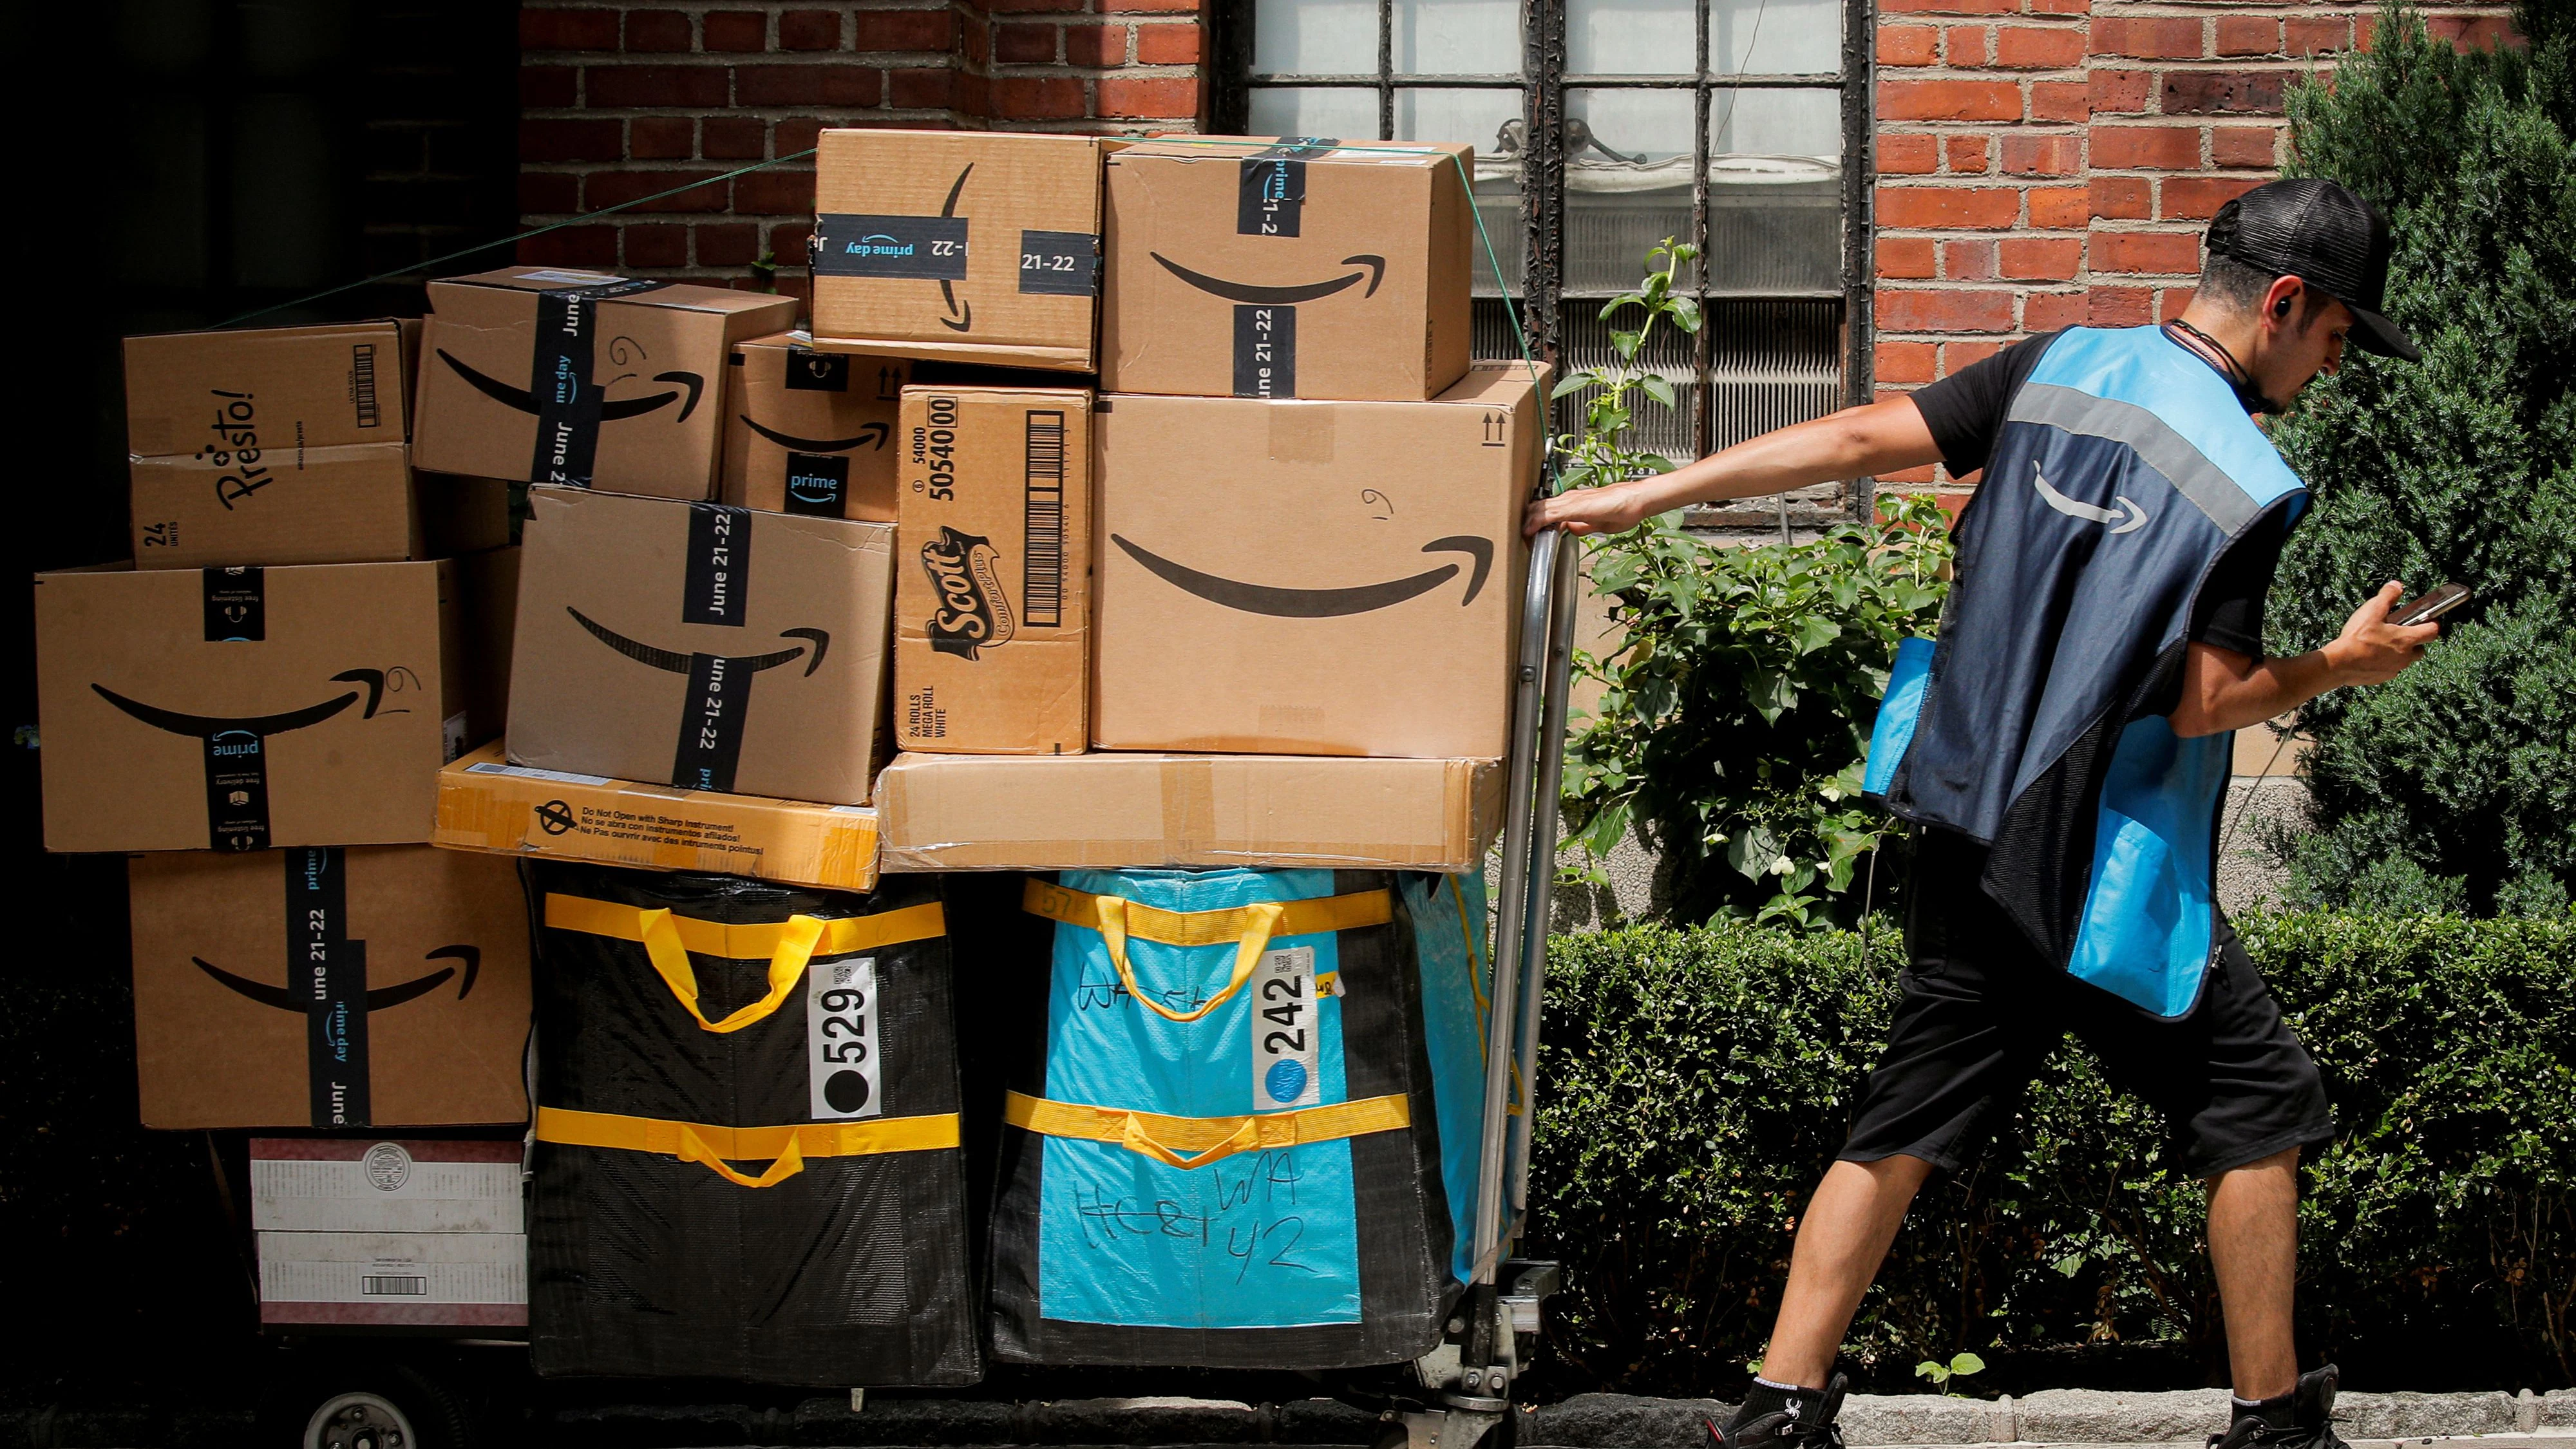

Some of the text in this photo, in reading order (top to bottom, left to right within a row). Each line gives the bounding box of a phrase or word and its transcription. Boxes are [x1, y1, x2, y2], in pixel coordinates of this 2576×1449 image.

[846, 242, 873, 256] day
[873, 243, 914, 258] prime
[1021, 254, 1075, 271] 21-22
[563, 294, 580, 337] June
[1255, 309, 1272, 361] 21-22
[555, 355, 571, 404] me day
[211, 389, 274, 511] Presto!
[553, 422, 573, 465] June
[913, 427, 926, 464] 54000
[929, 399, 955, 501] 50540 00
[791, 473, 837, 489] prime
[144, 522, 166, 547] 24
[709, 514, 731, 616] June 21-22
[923, 549, 986, 639] Scott
[709, 658, 725, 692] une
[699, 697, 723, 750] 21-22
[909, 694, 920, 737] 24 ROLLS
[922, 685, 934, 737] MEGA ROLL
[934, 708, 946, 738] WHITE
[213, 741, 259, 758] prime
[580, 826, 591, 835] Ne
[594, 827, 609, 837] Pas
[641, 834, 662, 843] avec
[663, 835, 679, 845] des
[728, 844, 764, 855] pointus!
[581, 816, 594, 825] No
[607, 820, 626, 829] abra
[628, 823, 644, 831] con
[646, 823, 702, 838] instrumentos
[703, 831, 741, 842] afilados!
[582, 807, 734, 833] Do Not Open with Sharp Instrument!
[305, 849, 327, 1000] une 21-22 prime
[821, 989, 867, 1064] 529
[1262, 974, 1305, 1054] 242
[332, 1001, 350, 1124] rime day June
